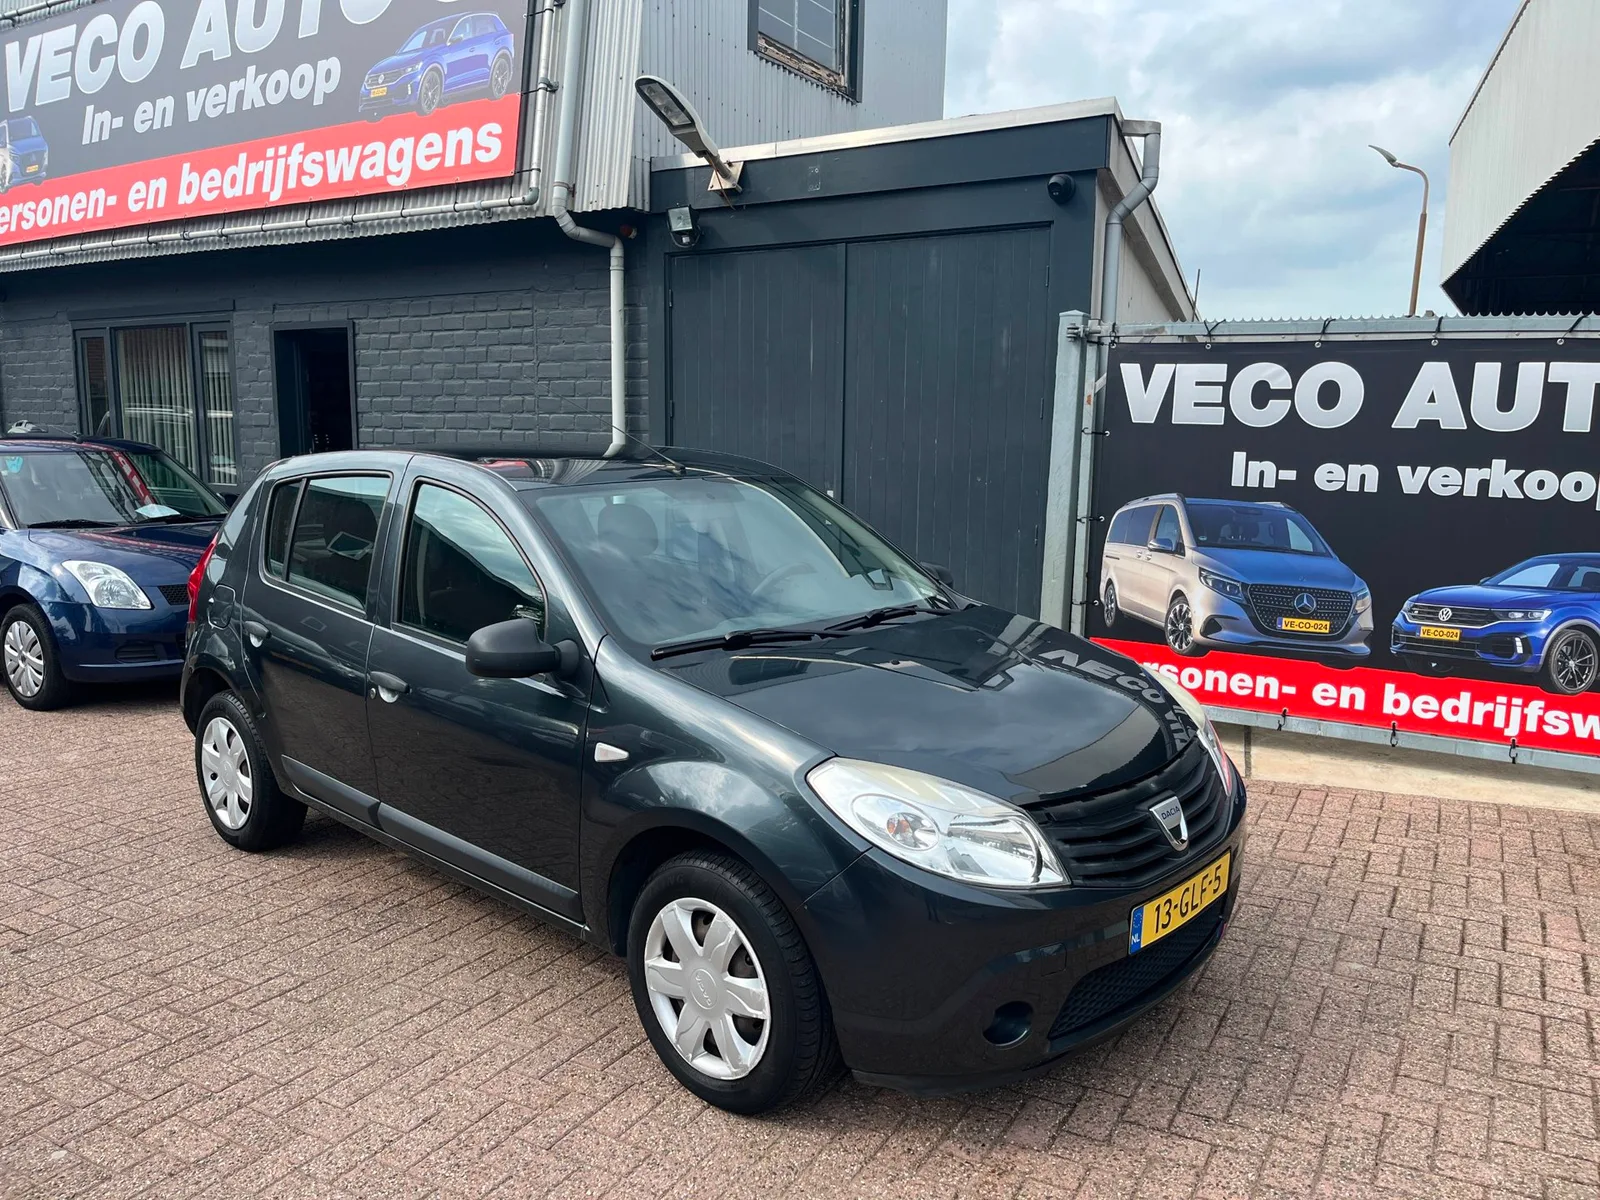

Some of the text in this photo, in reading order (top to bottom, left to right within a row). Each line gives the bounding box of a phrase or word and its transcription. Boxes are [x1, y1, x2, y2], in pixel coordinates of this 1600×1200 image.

[5, 0, 165, 113] VECO
[82, 56, 342, 145] In- en verkoop
[128, 176, 167, 212] en
[177, 121, 503, 205] bedrijfswagens
[1119, 361, 1365, 429] VECO
[1231, 451, 1600, 511] In- en verkoo
[1284, 620, 1328, 631] VE-CO-024
[1421, 628, 1459, 639] VE-CO-024
[1312, 682, 1366, 711] en
[1161, 805, 1180, 820] DACIA
[1154, 863, 1222, 934] 13-GLF-5
[1131, 933, 1141, 945] NL
